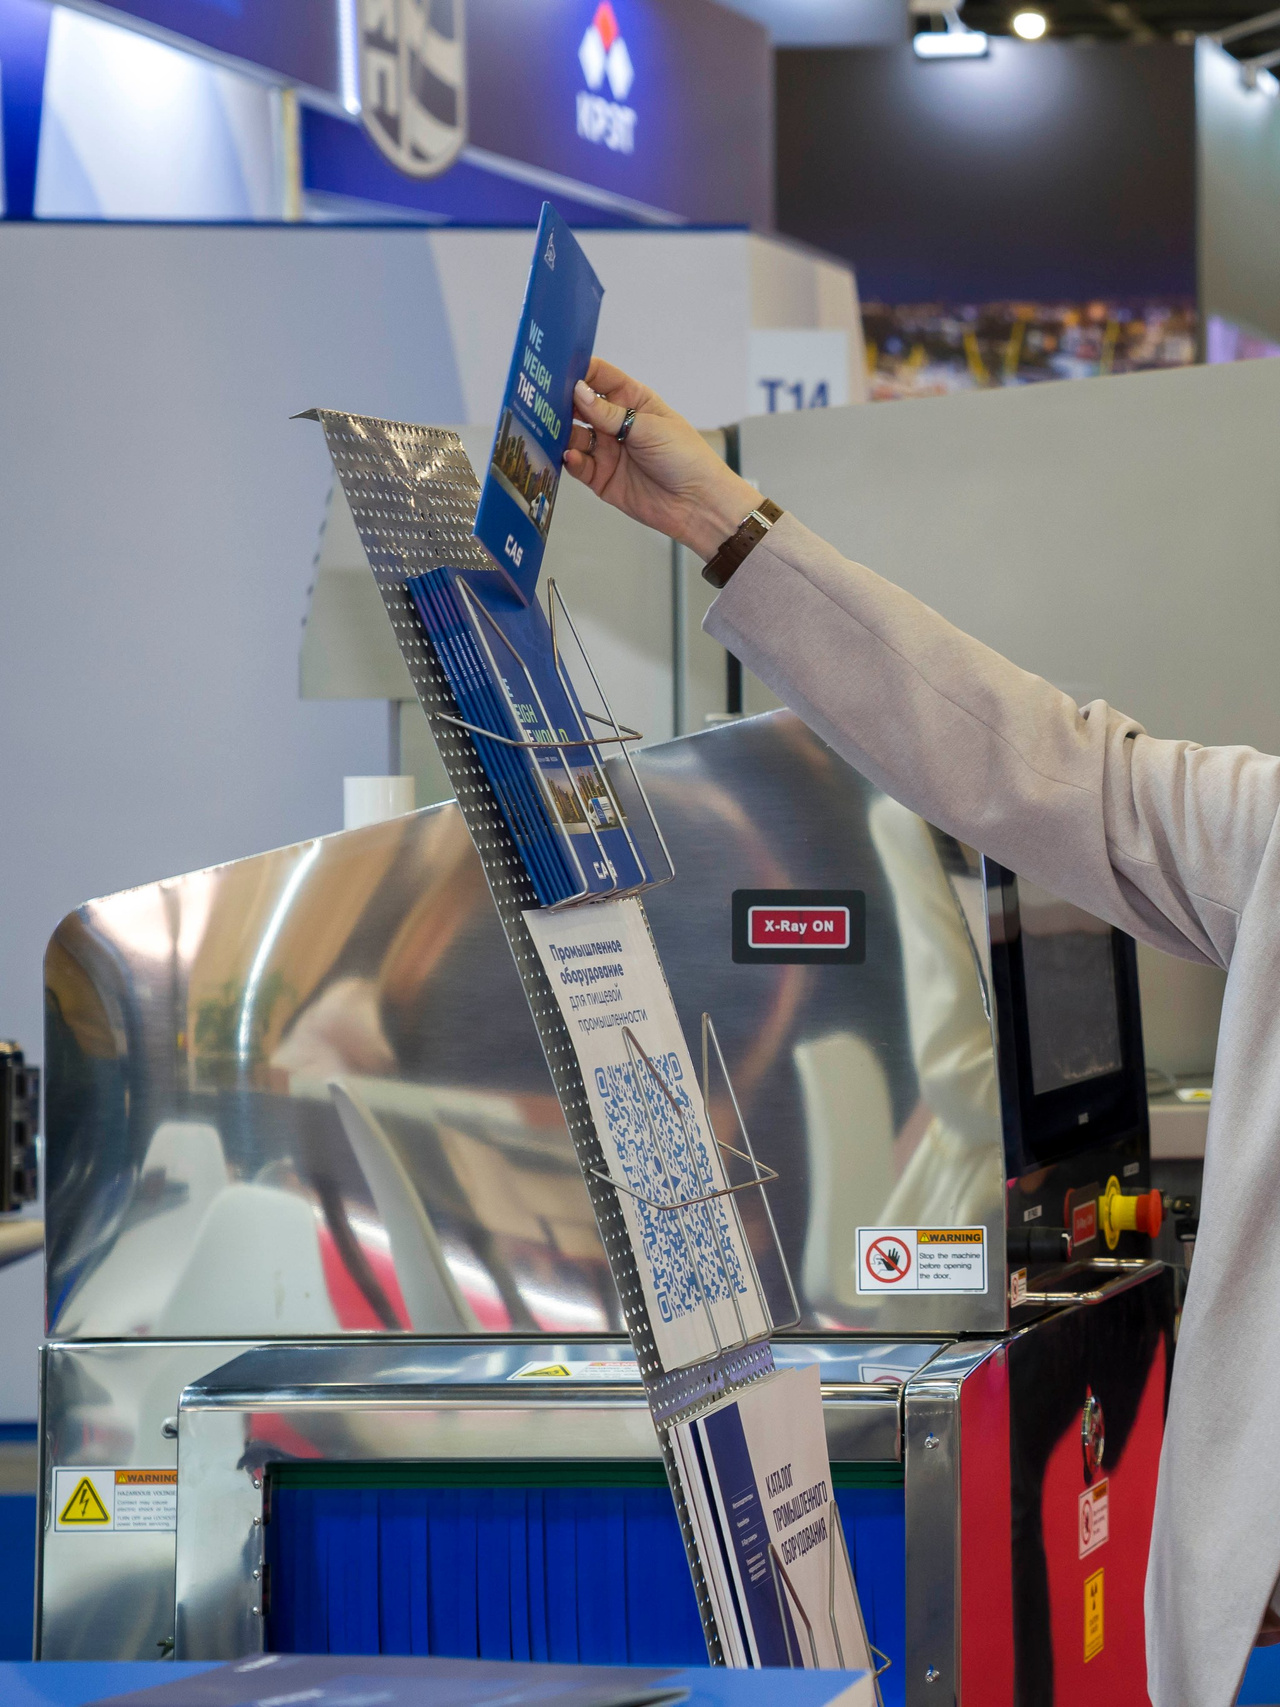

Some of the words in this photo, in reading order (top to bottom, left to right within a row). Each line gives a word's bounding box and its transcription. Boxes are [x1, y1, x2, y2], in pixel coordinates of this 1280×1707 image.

[529, 319, 544, 352] WE
[523, 345, 552, 394] WEIGH
[517, 371, 536, 408] THE
[534, 391, 561, 440] WORLD
[505, 533, 523, 568] CAS
[512, 703, 538, 723] EIGH
[765, 920, 807, 935] X-Ray
[812, 920, 834, 932] ON
[549, 939, 623, 965] Промышленное
[560, 963, 624, 987] оборудование
[569, 994, 588, 1011] для
[586, 983, 623, 1006] пищевой
[578, 1008, 649, 1036] промышленности
[929, 1233, 981, 1243] WARNING
[919, 1252, 935, 1261] Stop
[938, 1252, 949, 1260] the
[951, 1252, 981, 1260] machine
[919, 1262, 941, 1270] before
[944, 1263, 972, 1271] opening
[919, 1272, 931, 1280] the
[127, 1474, 177, 1483] WARNING
[765, 1463, 794, 1499] КАТАЛОГ
[772, 1480, 828, 1533] ПРОМЫШЛЕННОГО
[780, 1517, 828, 1566] ОБОРУДОВАНИЯ
